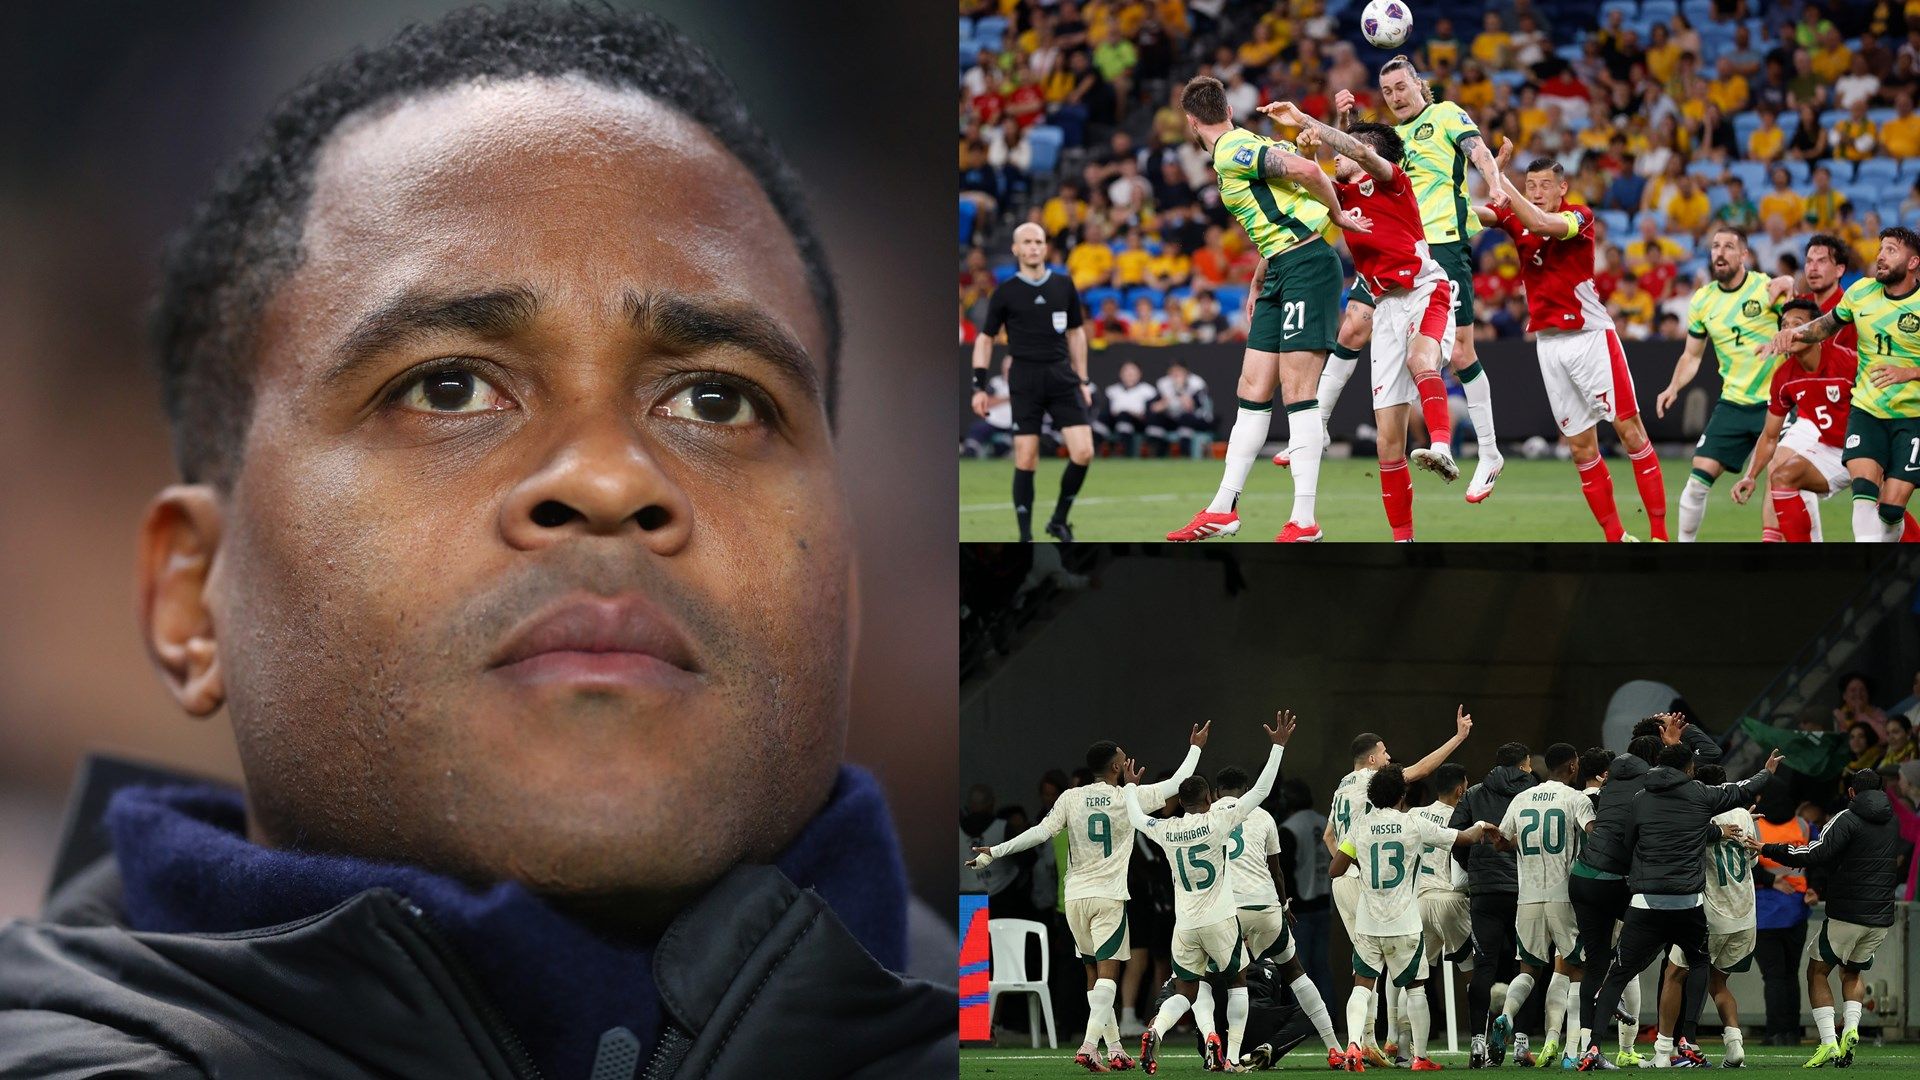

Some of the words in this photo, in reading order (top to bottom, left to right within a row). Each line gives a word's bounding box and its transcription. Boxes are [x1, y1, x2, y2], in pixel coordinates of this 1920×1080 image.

[1282, 301, 1306, 331] 21
[1731, 326, 1744, 347] 2
[1874, 333, 1893, 356] 11
[1814, 405, 1833, 430] 5
[1086, 796, 1112, 807] FERAS
[1531, 792, 1557, 802] RADIF
[1087, 812, 1113, 859] 9
[1370, 823, 1402, 835] YASSER
[1519, 808, 1566, 856] 20
[1175, 843, 1217, 892] 15
[1370, 840, 1406, 890] 13
[1714, 840, 1747, 887] 10
